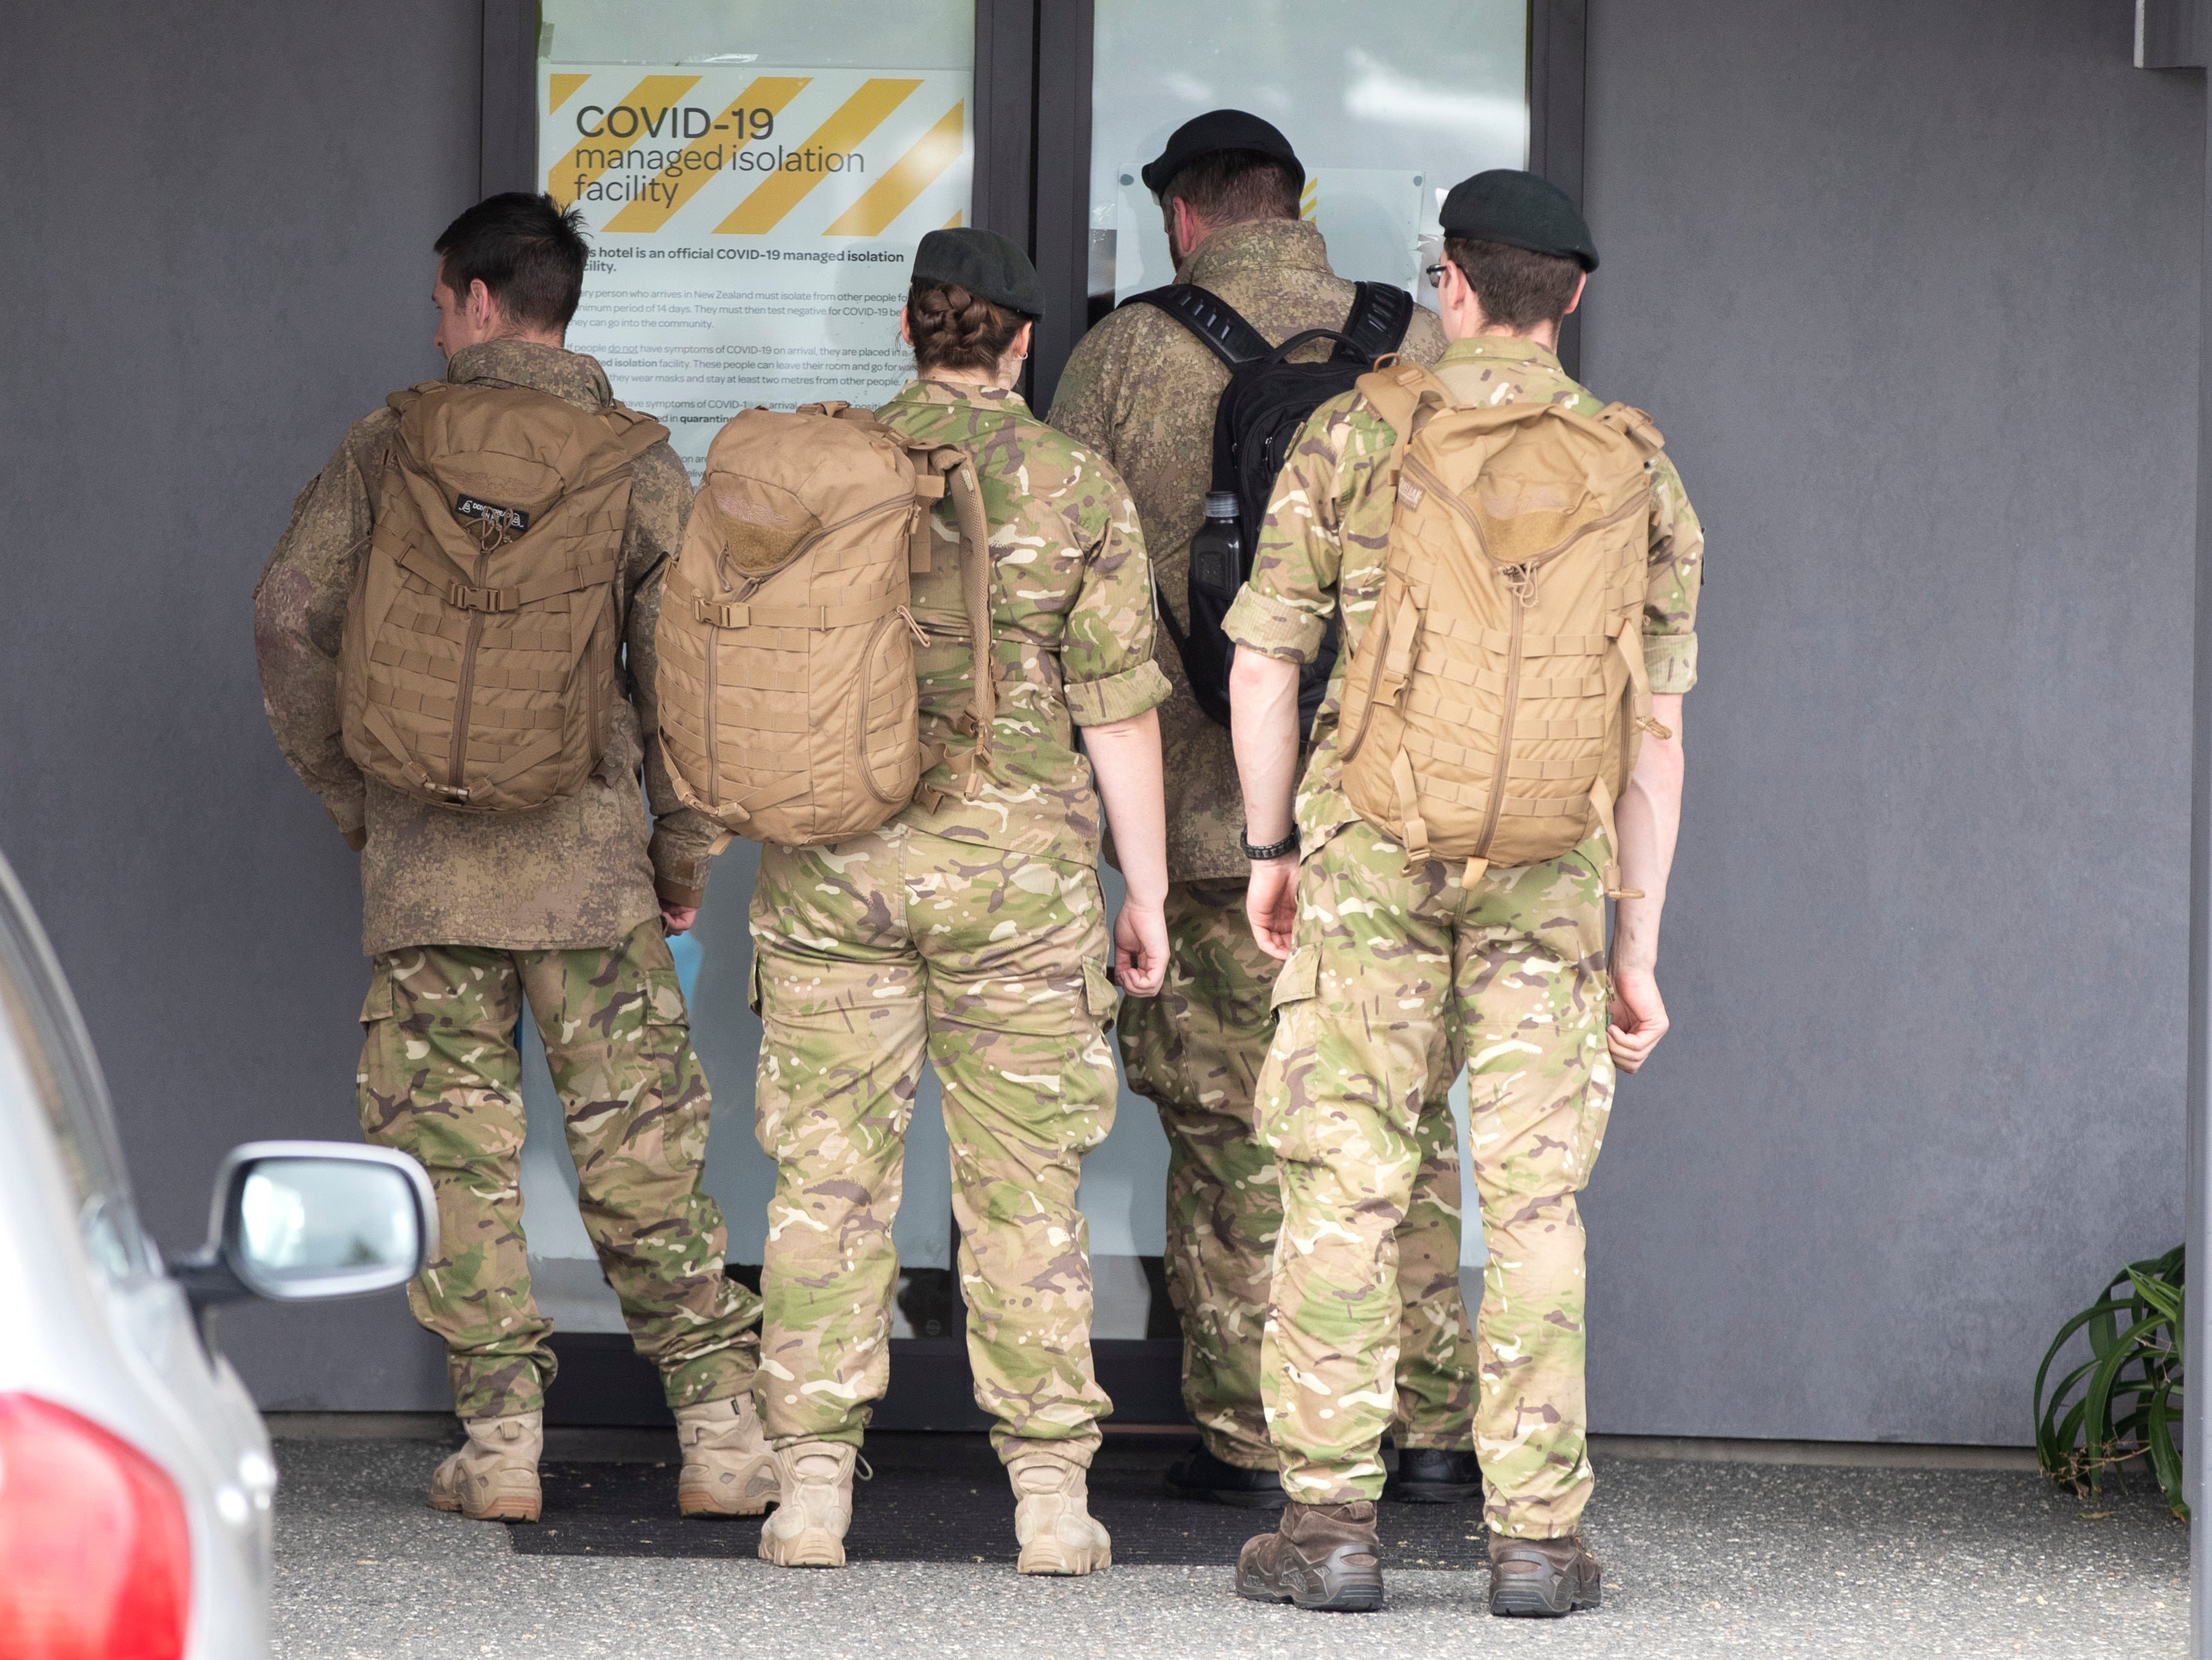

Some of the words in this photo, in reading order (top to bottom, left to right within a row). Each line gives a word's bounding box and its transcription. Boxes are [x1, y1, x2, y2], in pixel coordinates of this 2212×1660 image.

[577, 105, 775, 141] COVID-19
[576, 144, 723, 178] managed
[732, 145, 865, 173] isolation
[574, 173, 679, 208] facility
[599, 247, 633, 258] hotel
[636, 247, 646, 258] is
[649, 249, 665, 259] an
[668, 247, 714, 260] official
[717, 248, 781, 260] COVID-19
[783, 250, 845, 264] managed
[847, 250, 905, 262] isolation
[596, 290, 628, 299] person
[629, 289, 649, 298] who
[651, 290, 682, 299] arrives
[684, 290, 692, 299] in
[694, 290, 716, 300] New
[716, 290, 754, 300] Zealand
[755, 292, 779, 300] must
[781, 291, 811, 301] isolate
[813, 292, 835, 301] from
[837, 292, 863, 302] other
[864, 293, 897, 303] people
[613, 304, 644, 314] period
[645, 304, 656, 313] of
[657, 304, 667, 313] 14
[668, 304, 693, 315] days.
[695, 304, 718, 315] They
[719, 306, 742, 315] must
[745, 306, 767, 315] then
[767, 306, 785, 315] test
[787, 306, 827, 317] negative
[828, 306, 841, 316] for
[843, 307, 889, 317] COVID-19
[589, 319, 607, 328] can
[607, 319, 620, 330] go
[621, 318, 640, 328] into
[641, 318, 657, 328] the
[658, 319, 714, 330] community.
[575, 343, 607, 354] people
[608, 344, 621, 354] do
[622, 344, 639, 354] not
[639, 344, 663, 353] have
[664, 345, 714, 355] symptoms
[715, 345, 726, 354] of
[727, 345, 772, 355] COVID-19
[773, 347, 786, 356] on
[820, 346, 841, 358] they
[841, 348, 857, 357] are
[859, 348, 891, 358] placed
[615, 358, 657, 368] isolation
[694, 359, 722, 369] These
[723, 360, 756, 370] people
[757, 362, 775, 370] can
[776, 360, 801, 370] leave
[803, 361, 823, 370] their
[852, 362, 870, 371] and
[871, 363, 883, 373] go
[885, 362, 897, 372] for
[609, 373, 630, 384] they
[655, 374, 685, 384] masks
[686, 374, 704, 384] and
[705, 375, 726, 385] stay
[738, 375, 761, 385] least
[762, 376, 780, 385] two
[781, 376, 815, 385] metres
[816, 376, 839, 385] from
[840, 376, 865, 386] other
[645, 400, 695, 410] symptoms
[697, 400, 707, 409] of
[670, 414, 679, 423] in
